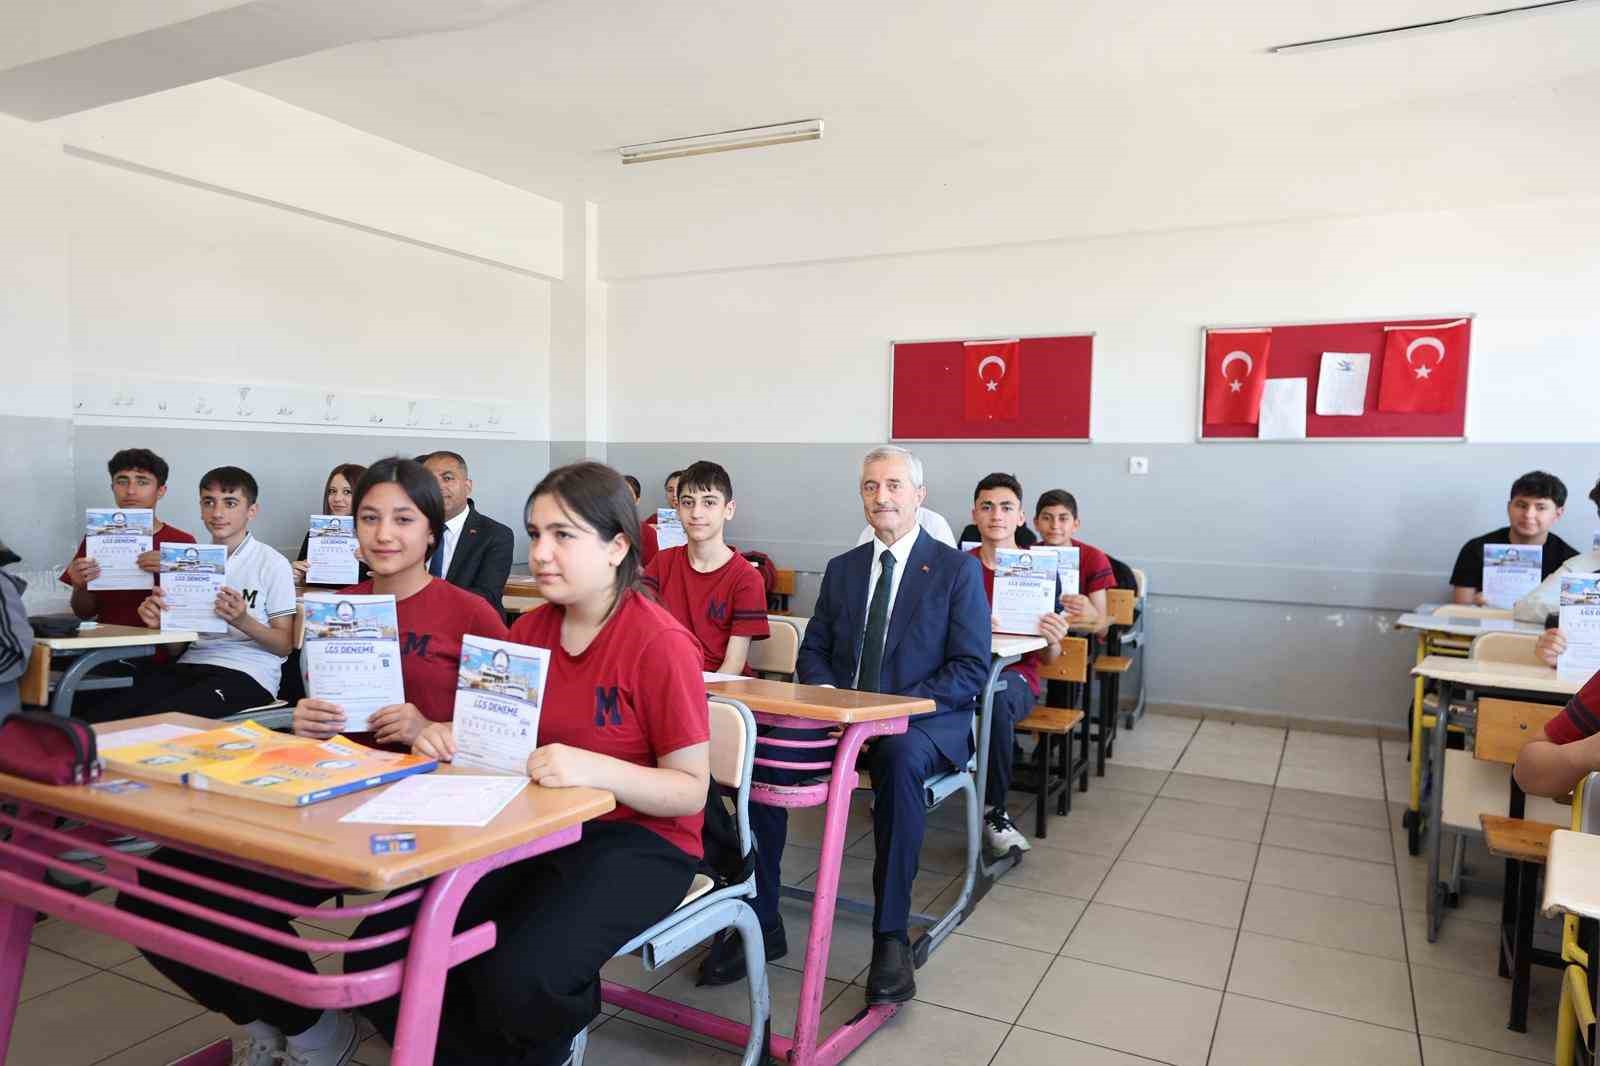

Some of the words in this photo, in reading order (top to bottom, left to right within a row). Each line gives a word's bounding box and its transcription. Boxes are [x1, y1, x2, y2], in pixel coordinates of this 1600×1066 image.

[243, 588, 258, 609] M
[708, 598, 727, 620] M
[324, 645, 340, 654] LGS
[340, 645, 375, 654] DENEME
[400, 631, 432, 657] M
[382, 658, 390, 668] B
[473, 698, 488, 710] LGS
[488, 701, 519, 717] DENEME
[594, 686, 623, 727] M
